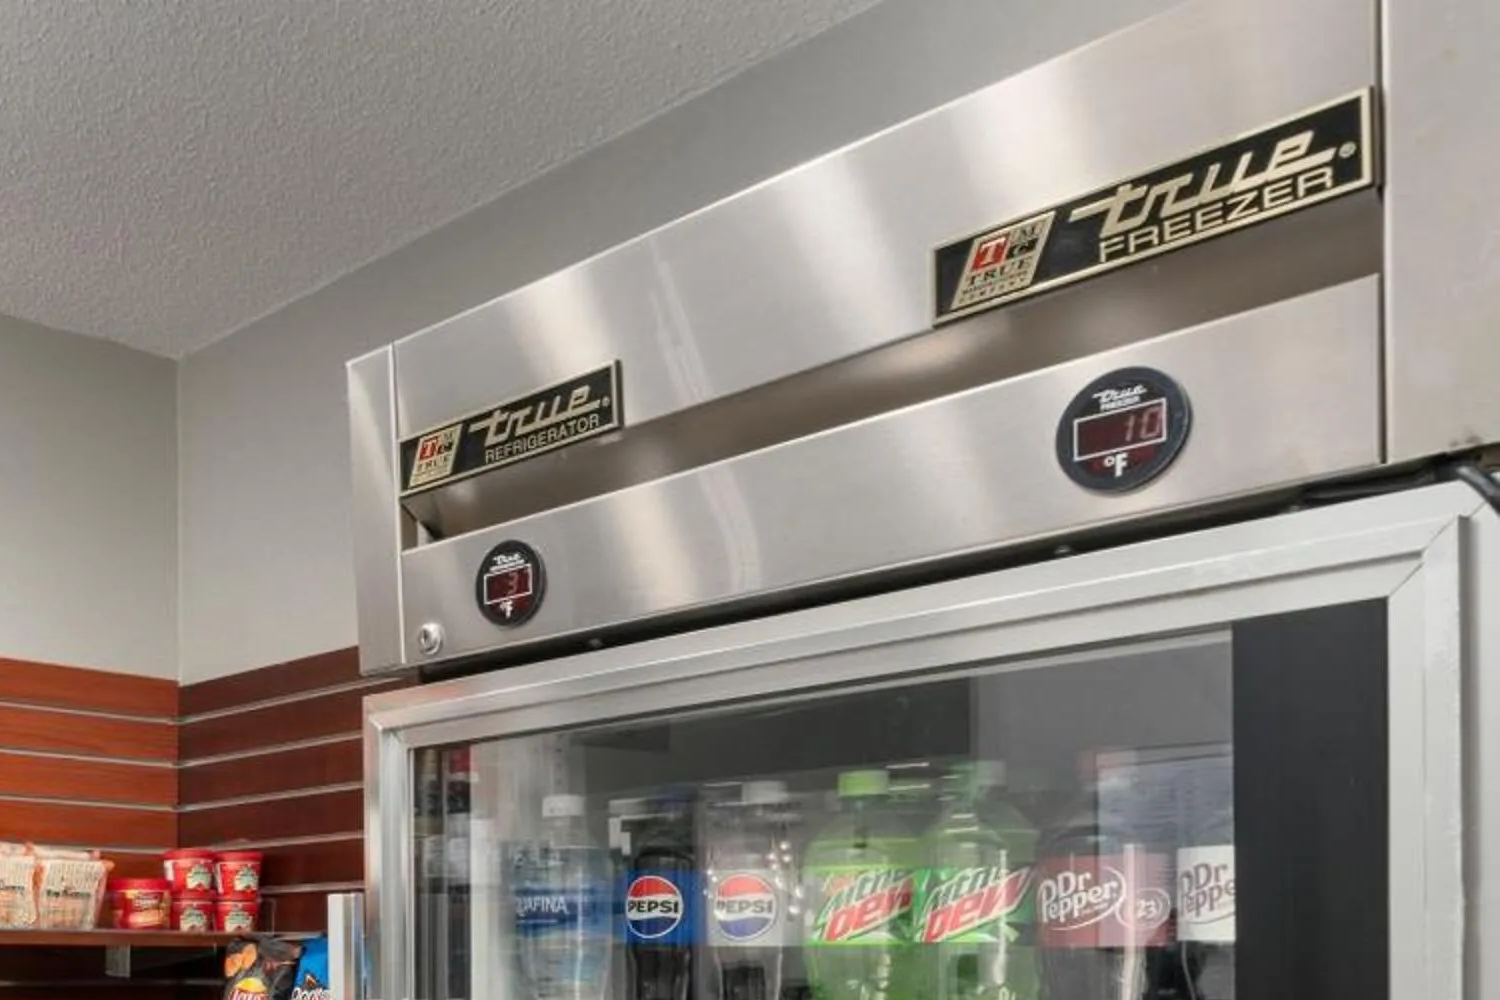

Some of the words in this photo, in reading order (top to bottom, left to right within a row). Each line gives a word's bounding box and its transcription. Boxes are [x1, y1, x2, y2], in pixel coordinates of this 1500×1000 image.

[1099, 166, 1335, 264] FREEZER
[484, 412, 600, 465] REFRIGERATOR
[1057, 871, 1092, 899] Dr
[1193, 862, 1228, 887] Dr
[627, 898, 679, 915] PEPSI
[716, 899, 773, 916] PEPSI
[1040, 879, 1119, 923] Pepper
[1179, 869, 1235, 918] Peppe
